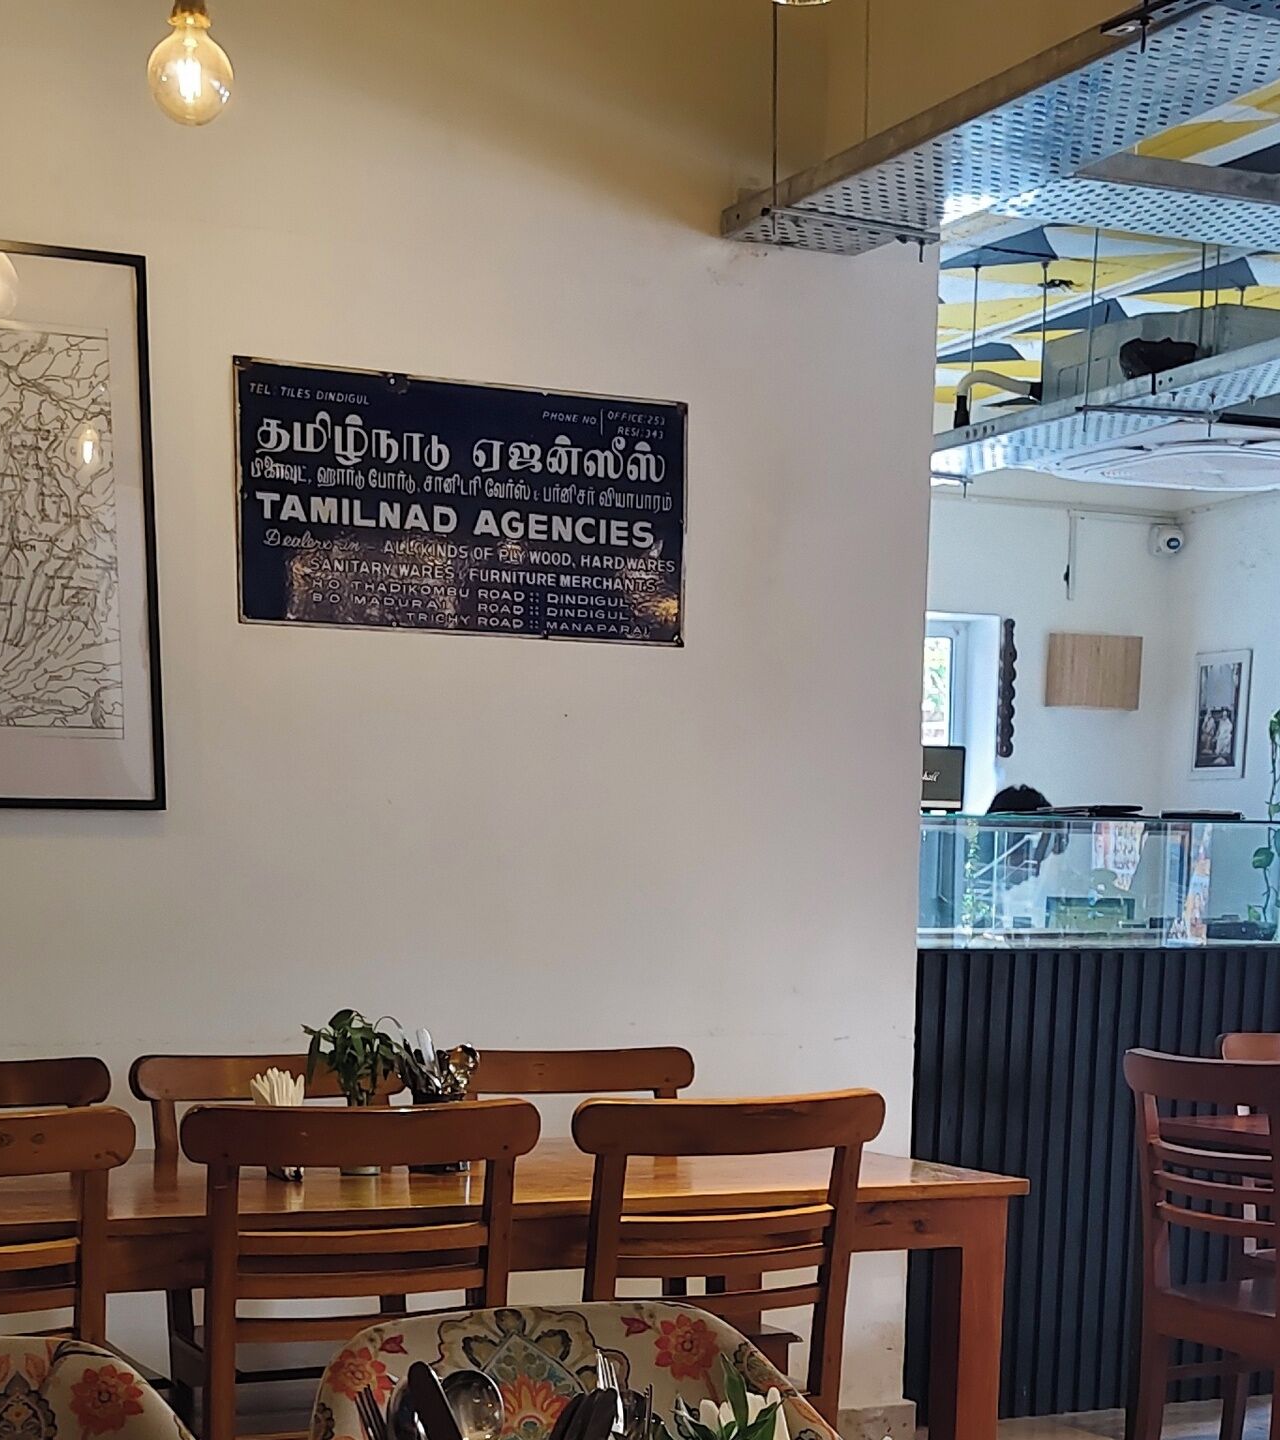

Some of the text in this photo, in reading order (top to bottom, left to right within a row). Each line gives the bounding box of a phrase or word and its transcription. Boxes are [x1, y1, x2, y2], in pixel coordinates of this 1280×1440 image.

[280, 386, 311, 399] TILES
[315, 390, 370, 405] DINDIGUL
[542, 410, 578, 423] PHONE
[256, 411, 665, 482] தமிழ்நாடு ஏஜன்ஸீஸ்
[484, 477, 531, 501] வேர்ஸ்
[599, 487, 673, 514] வியாபாரம்
[255, 490, 458, 534] TAMILNAD
[473, 546, 494, 561] OF
[580, 555, 675, 573] HARDWARES
[309, 558, 393, 575] SANITARY
[398, 563, 455, 579] WARES
[469, 568, 556, 587] FURNITURE
[477, 588, 525, 602] ROAD
[406, 612, 470, 626] TRICHY
[477, 617, 524, 629] ROAD
[477, 603, 524, 616] ROAD
